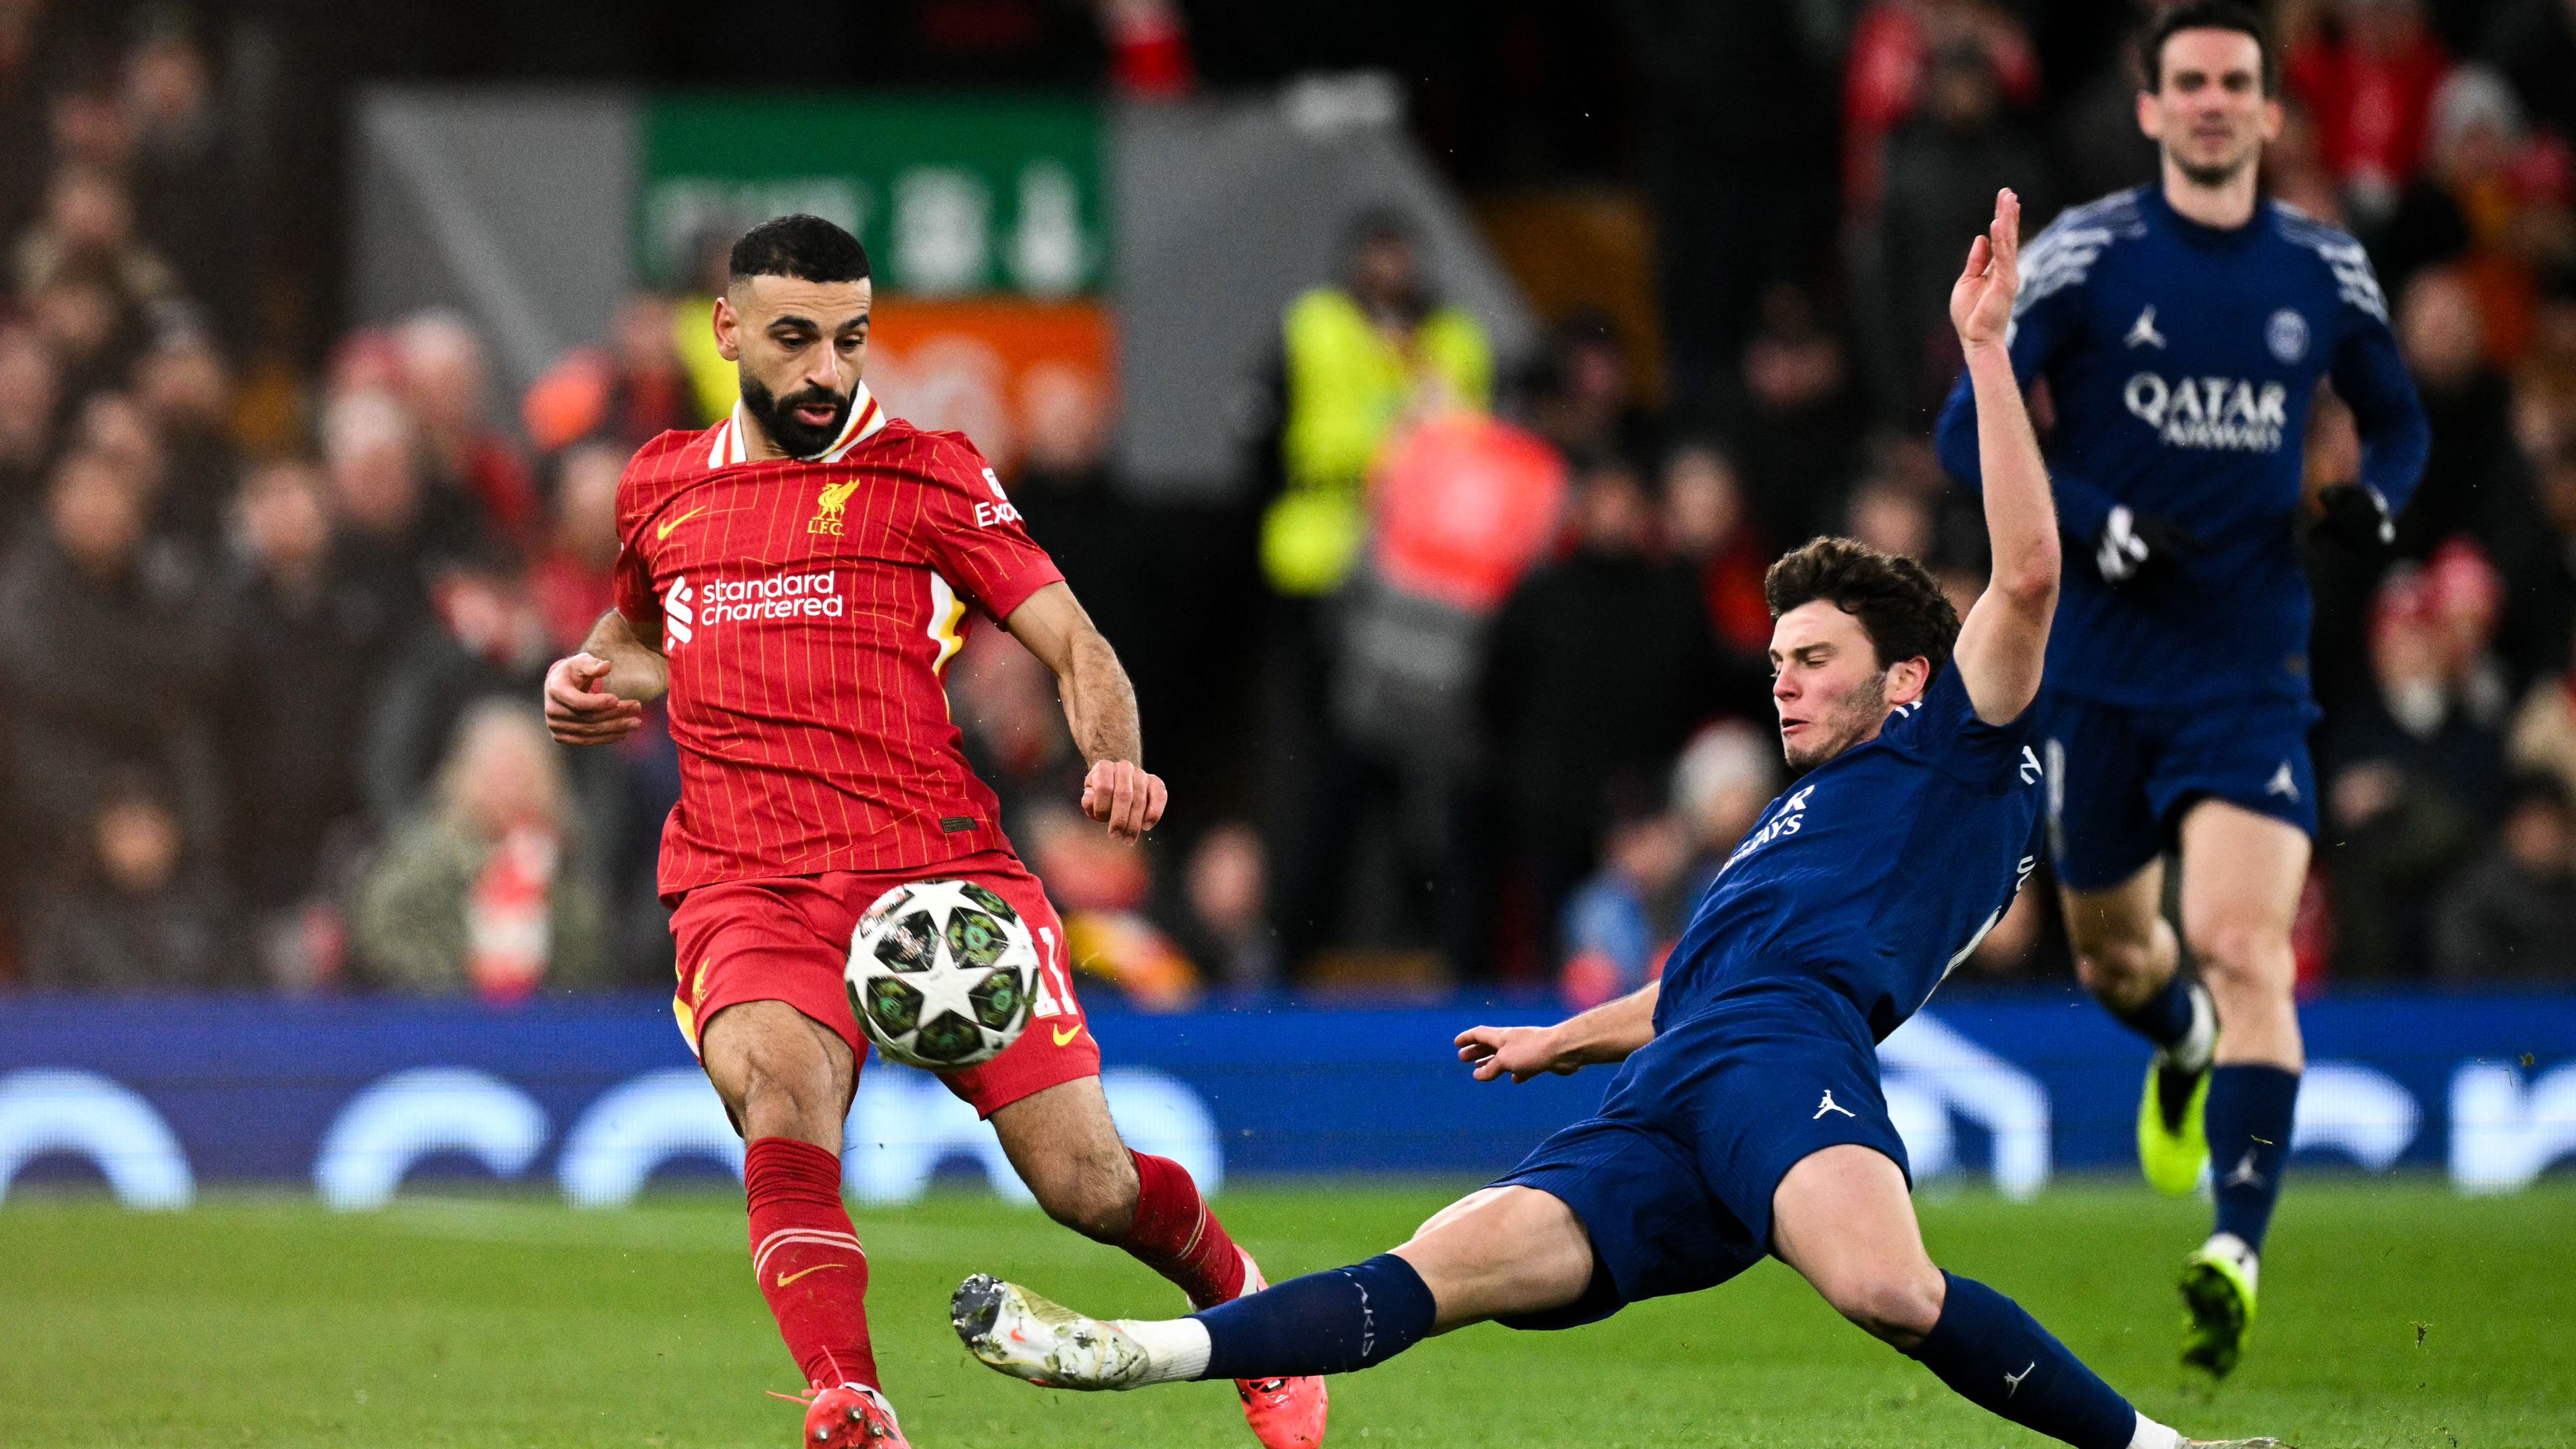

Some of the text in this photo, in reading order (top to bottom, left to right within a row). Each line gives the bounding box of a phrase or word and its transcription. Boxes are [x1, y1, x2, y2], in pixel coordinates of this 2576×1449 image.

[2124, 371, 2287, 428] QATAR
[702, 570, 835, 604] standard
[702, 594, 843, 626] chartered
